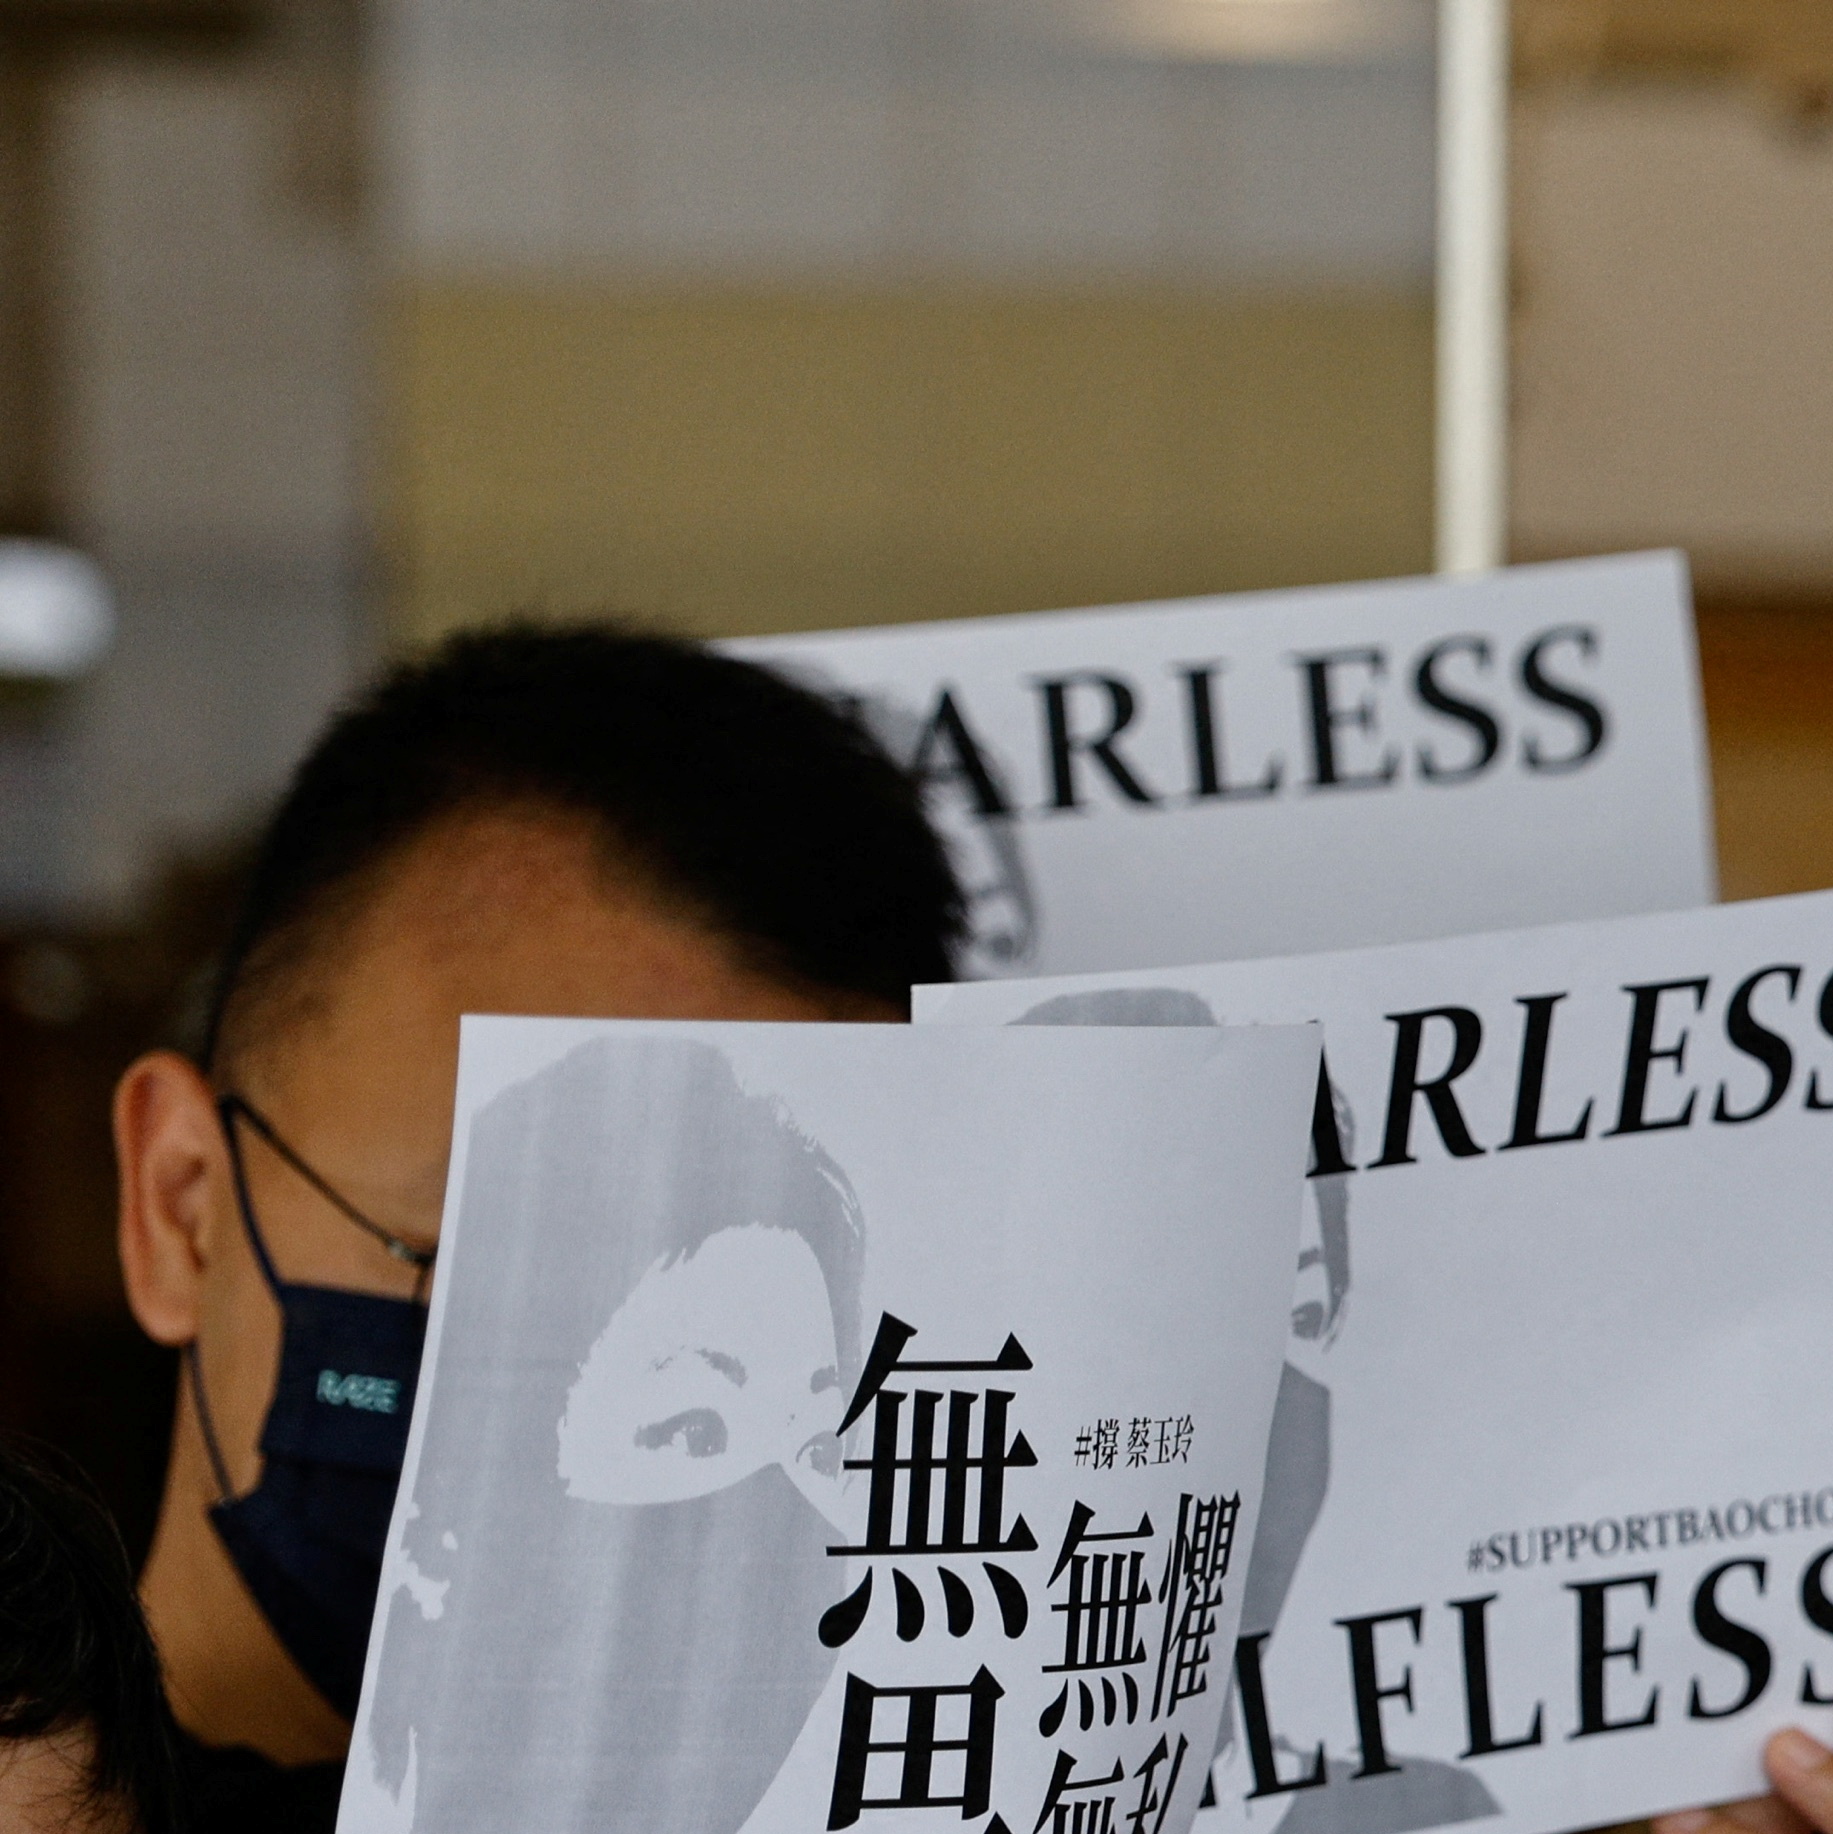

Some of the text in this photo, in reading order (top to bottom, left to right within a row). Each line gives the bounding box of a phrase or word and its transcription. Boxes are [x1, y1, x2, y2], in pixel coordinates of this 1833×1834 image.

[880, 622, 1608, 822] ARLESS
[1126, 1414, 1195, 1469] 蔡玉玲
[1038, 1491, 1241, 1738] 無懼
